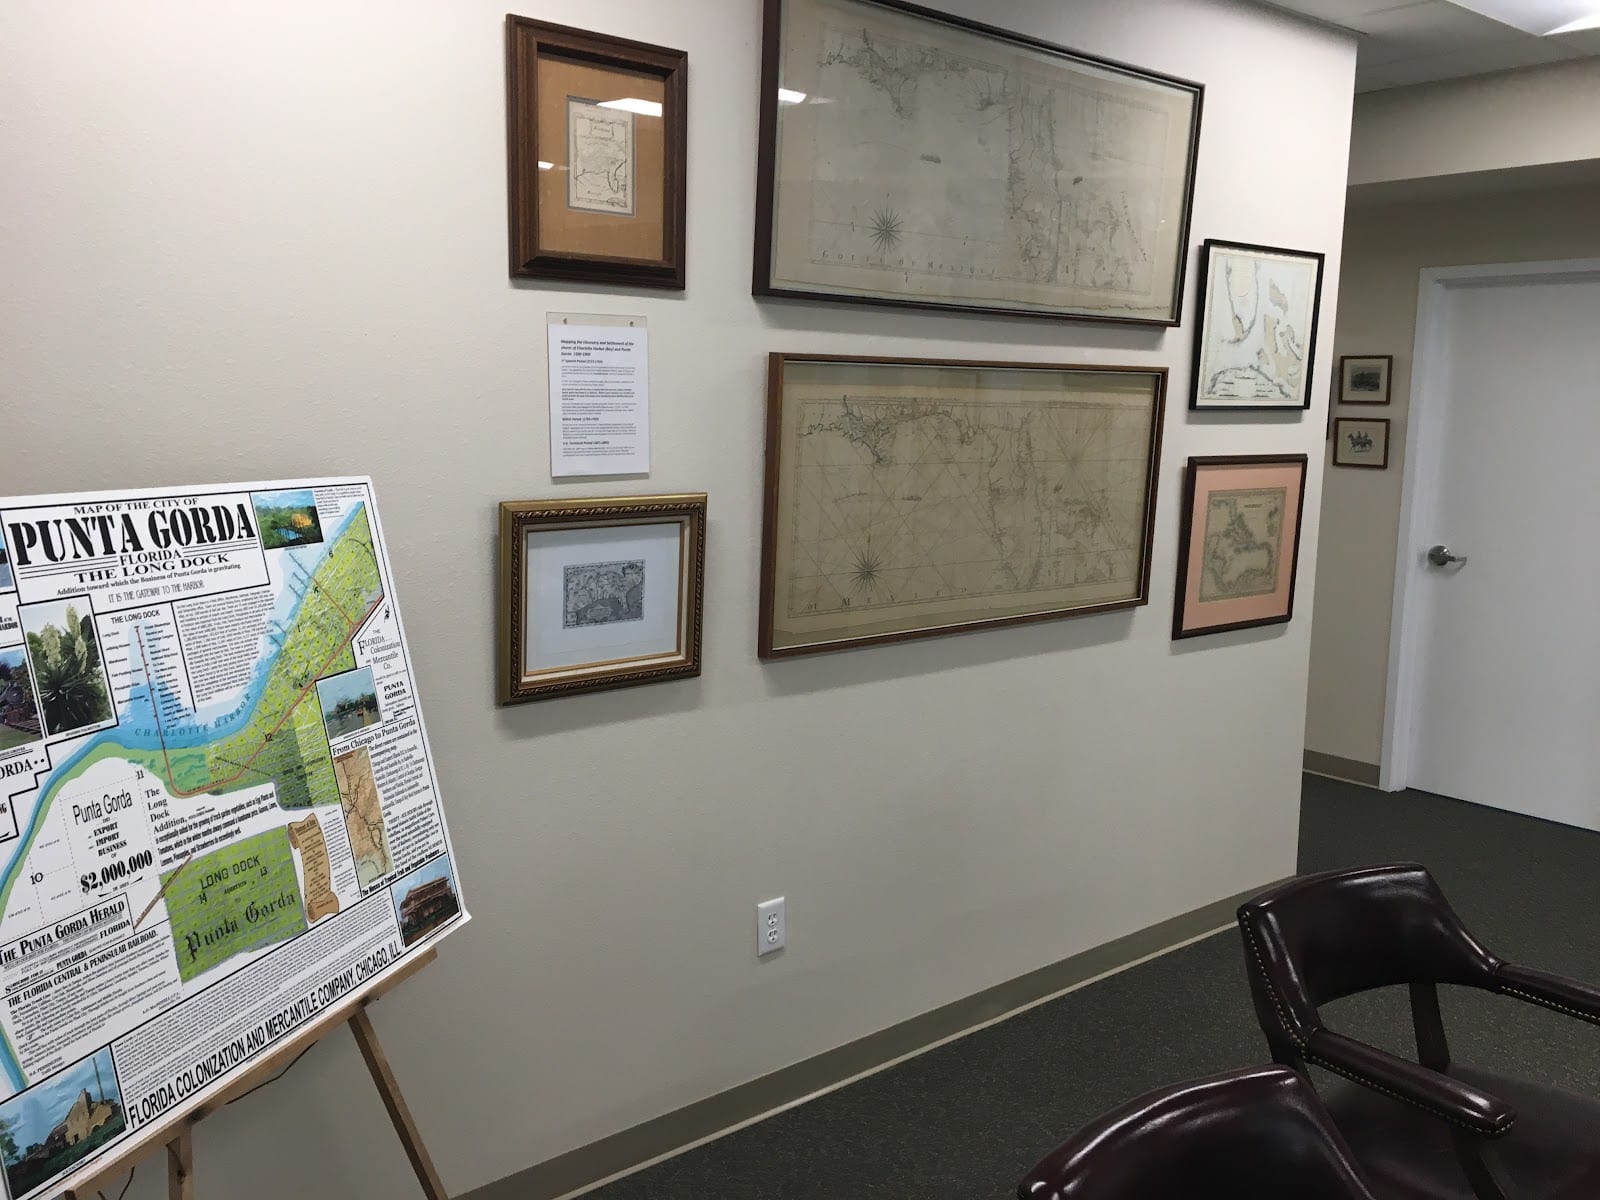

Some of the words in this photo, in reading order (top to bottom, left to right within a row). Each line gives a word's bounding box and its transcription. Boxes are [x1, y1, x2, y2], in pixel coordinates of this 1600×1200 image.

[73, 505, 103, 516] MAP
[105, 502, 124, 512] OF
[126, 500, 151, 511] THE
[152, 498, 181, 508] CITY
[183, 497, 199, 506] OF
[7, 511, 144, 566] PUNTA
[147, 503, 256, 550] GORDA
[119, 549, 182, 567] FLORIDA
[74, 568, 117, 584] THE
[123, 560, 176, 577] LONG
[181, 553, 230, 569] DOCK
[56, 587, 85, 596] Addition
[86, 582, 110, 590] toward
[110, 579, 129, 587] which
[140, 574, 166, 583] Business
[173, 570, 190, 578] Punta
[110, 615, 124, 624] THE
[124, 613, 142, 622] LONG
[143, 609, 160, 619] DOCK
[384, 680, 404, 692] PUNTA
[332, 743, 350, 756] From
[350, 734, 374, 749] Chicago
[381, 726, 399, 738] Punta
[399, 719, 416, 731] Gorda
[144, 787, 160, 799] The
[72, 801, 102, 825] Punta
[103, 788, 133, 816] Gorda
[147, 798, 168, 811] Long
[150, 809, 170, 822] Dock
[93, 822, 118, 837] EXPORT
[95, 832, 120, 847] IMPORT
[98, 840, 127, 856] BUSINESS
[30, 872, 44, 885] 10
[80, 849, 153, 894] $2,000,000
[199, 867, 230, 890] LONG
[232, 855, 261, 876] DOCK
[20, 932, 53, 956] PUNTA
[55, 917, 89, 940] GORDA
[89, 901, 125, 924] HERALD
[99, 919, 131, 939] FLORIDA
[185, 917, 239, 963] Punta
[244, 891, 296, 923] Gorda
[56, 955, 71, 969] PUNTA
[8, 992, 22, 1007] THE
[23, 979, 53, 999] FLORIDA
[53, 968, 83, 987] CENTRAL
[83, 963, 89, 971] &
[90, 944, 127, 967] PENINSULAR
[129, 1083, 177, 1128] FLORIDA
[176, 1036, 247, 1098] COLONIZATION
[246, 1026, 265, 1052] AND
[266, 991, 319, 1040] MERCANTILE
